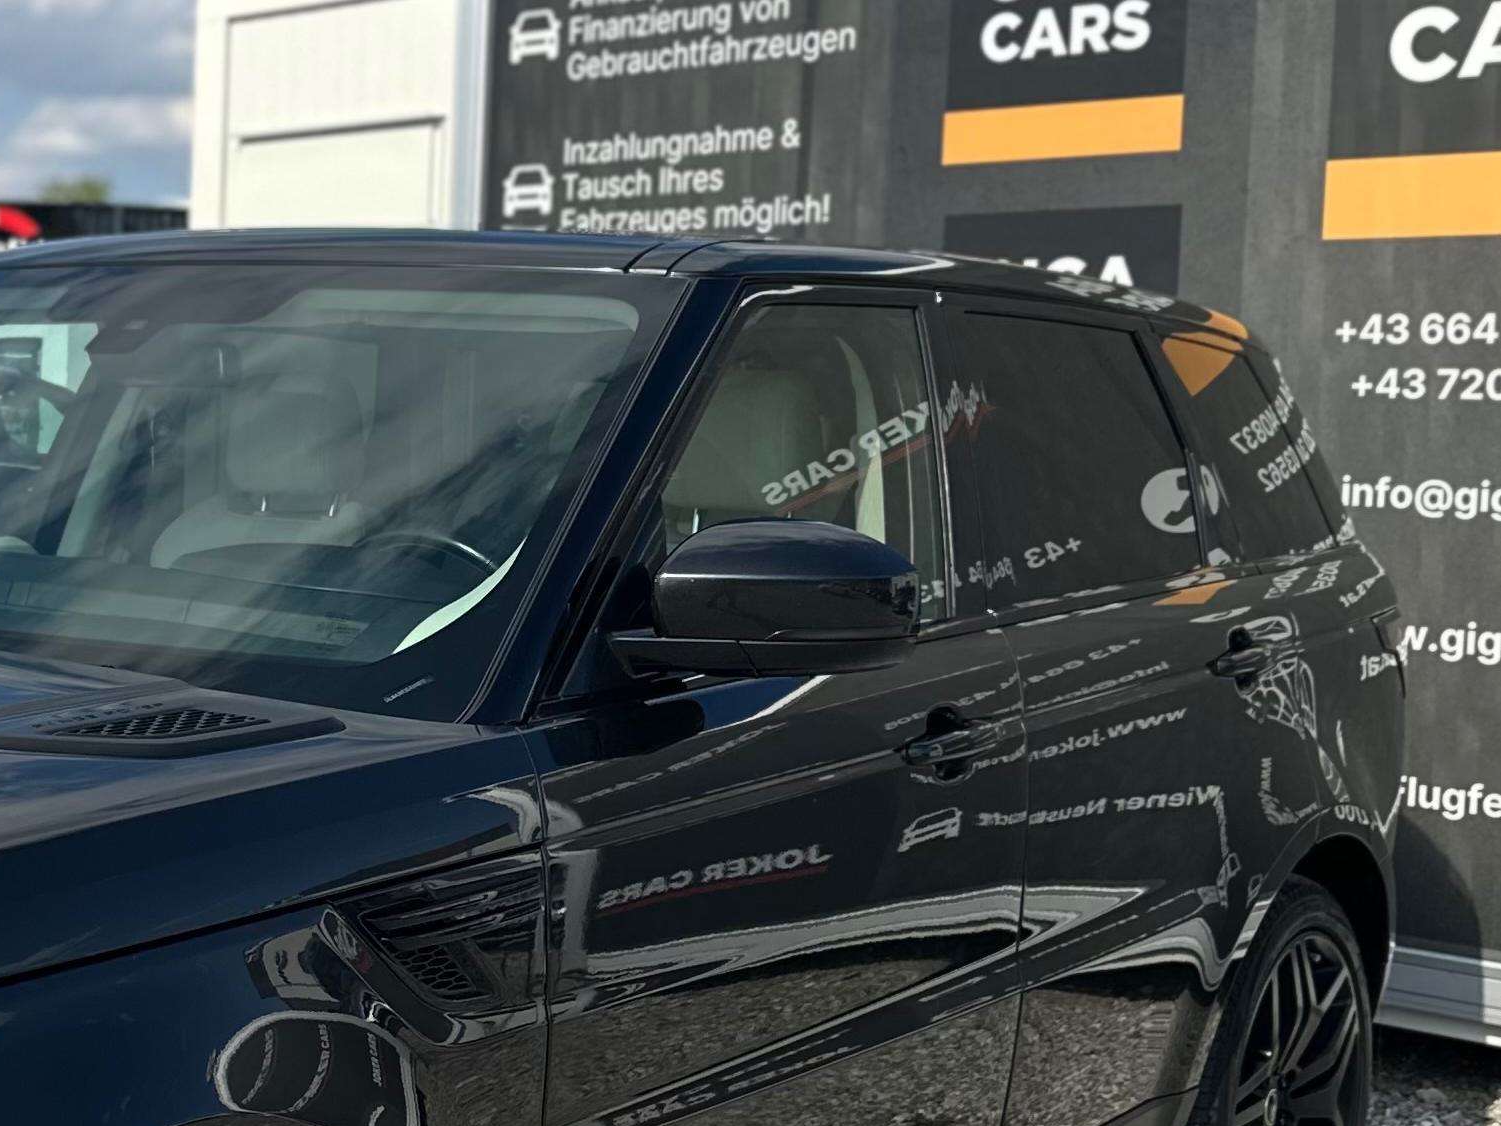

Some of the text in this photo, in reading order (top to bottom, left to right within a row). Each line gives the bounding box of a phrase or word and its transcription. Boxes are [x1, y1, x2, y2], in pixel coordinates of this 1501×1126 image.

[568, 0, 790, 45] Finanzierung von
[980, 0, 1152, 63] CARS
[566, 26, 857, 81] Gebrauchtfahrzeugen
[563, 118, 802, 166] Inzahlungnahme &
[561, 164, 724, 201] Tausch Ihres
[560, 194, 831, 234] Fahrzeuges möglich!
[1335, 312, 1499, 345] +43 664
[1351, 367, 1427, 400] +43
[1400, 774, 1501, 821] lugfe
